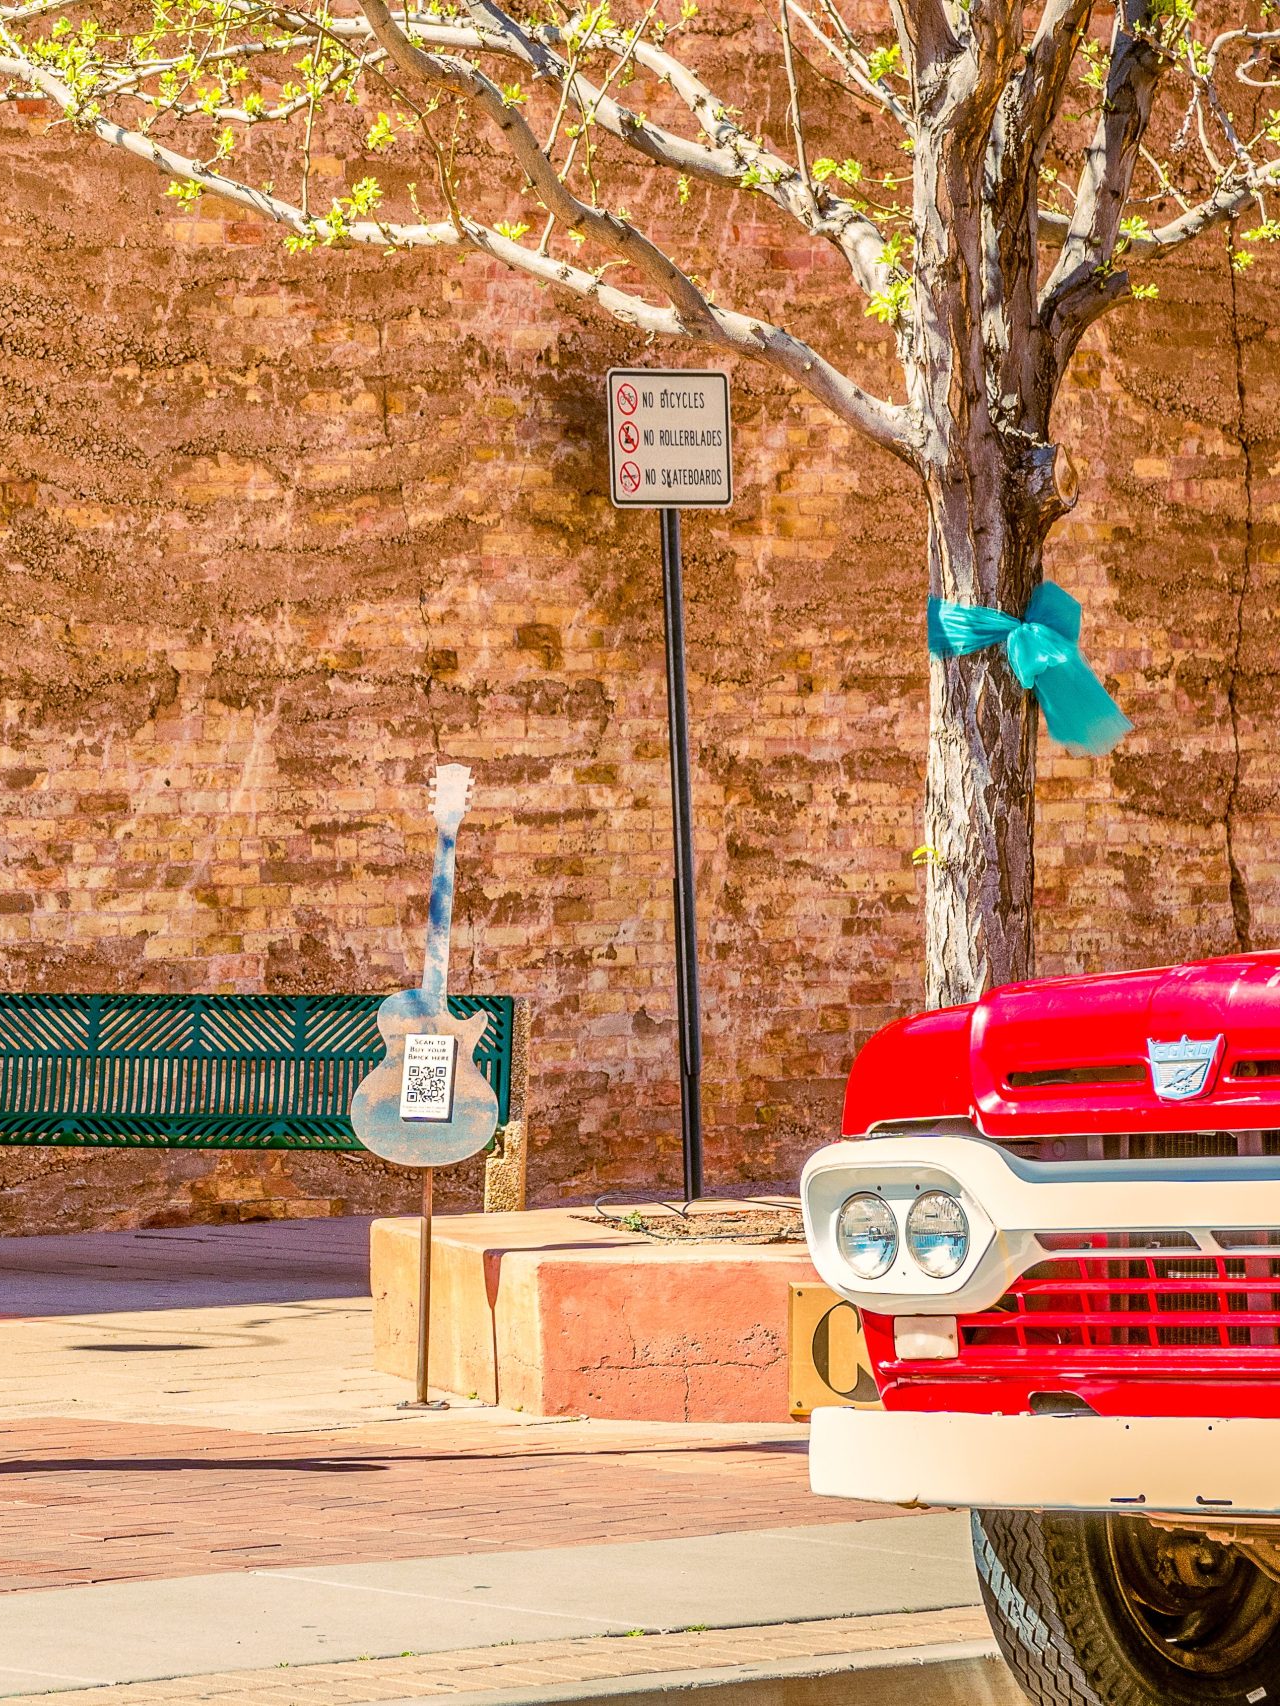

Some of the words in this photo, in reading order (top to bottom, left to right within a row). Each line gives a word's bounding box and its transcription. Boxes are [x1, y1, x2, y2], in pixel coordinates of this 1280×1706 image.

[642, 391, 654, 408] NO
[660, 391, 705, 409] BICYCLES
[643, 429, 655, 446] NO
[659, 429, 723, 447] ROLLERBLADES
[645, 468, 656, 485] NO
[661, 468, 722, 487] SKATEBOARDS
[1153, 1042, 1212, 1058] FORD
